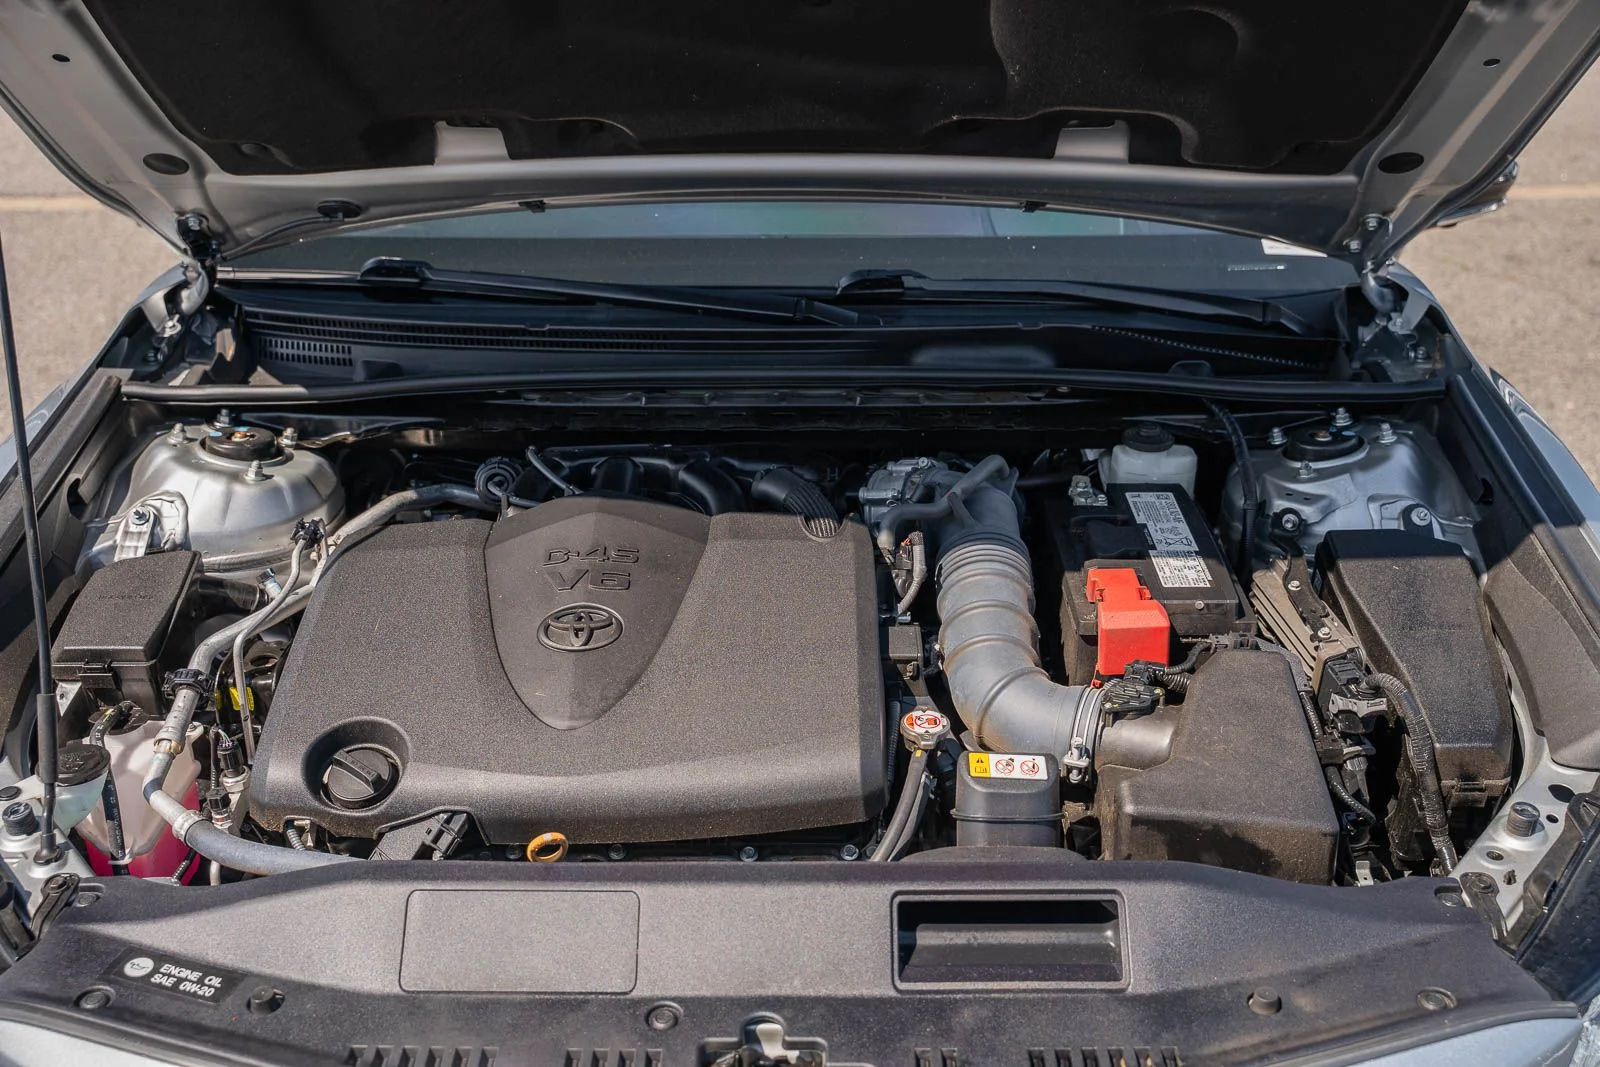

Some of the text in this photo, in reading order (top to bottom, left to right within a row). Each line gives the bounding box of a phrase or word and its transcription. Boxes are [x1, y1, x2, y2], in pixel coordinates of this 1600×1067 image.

[544, 569, 631, 591] V6
[150, 974, 215, 997] SAE 0W-20
[159, 964, 223, 988] ENGINE OIL
